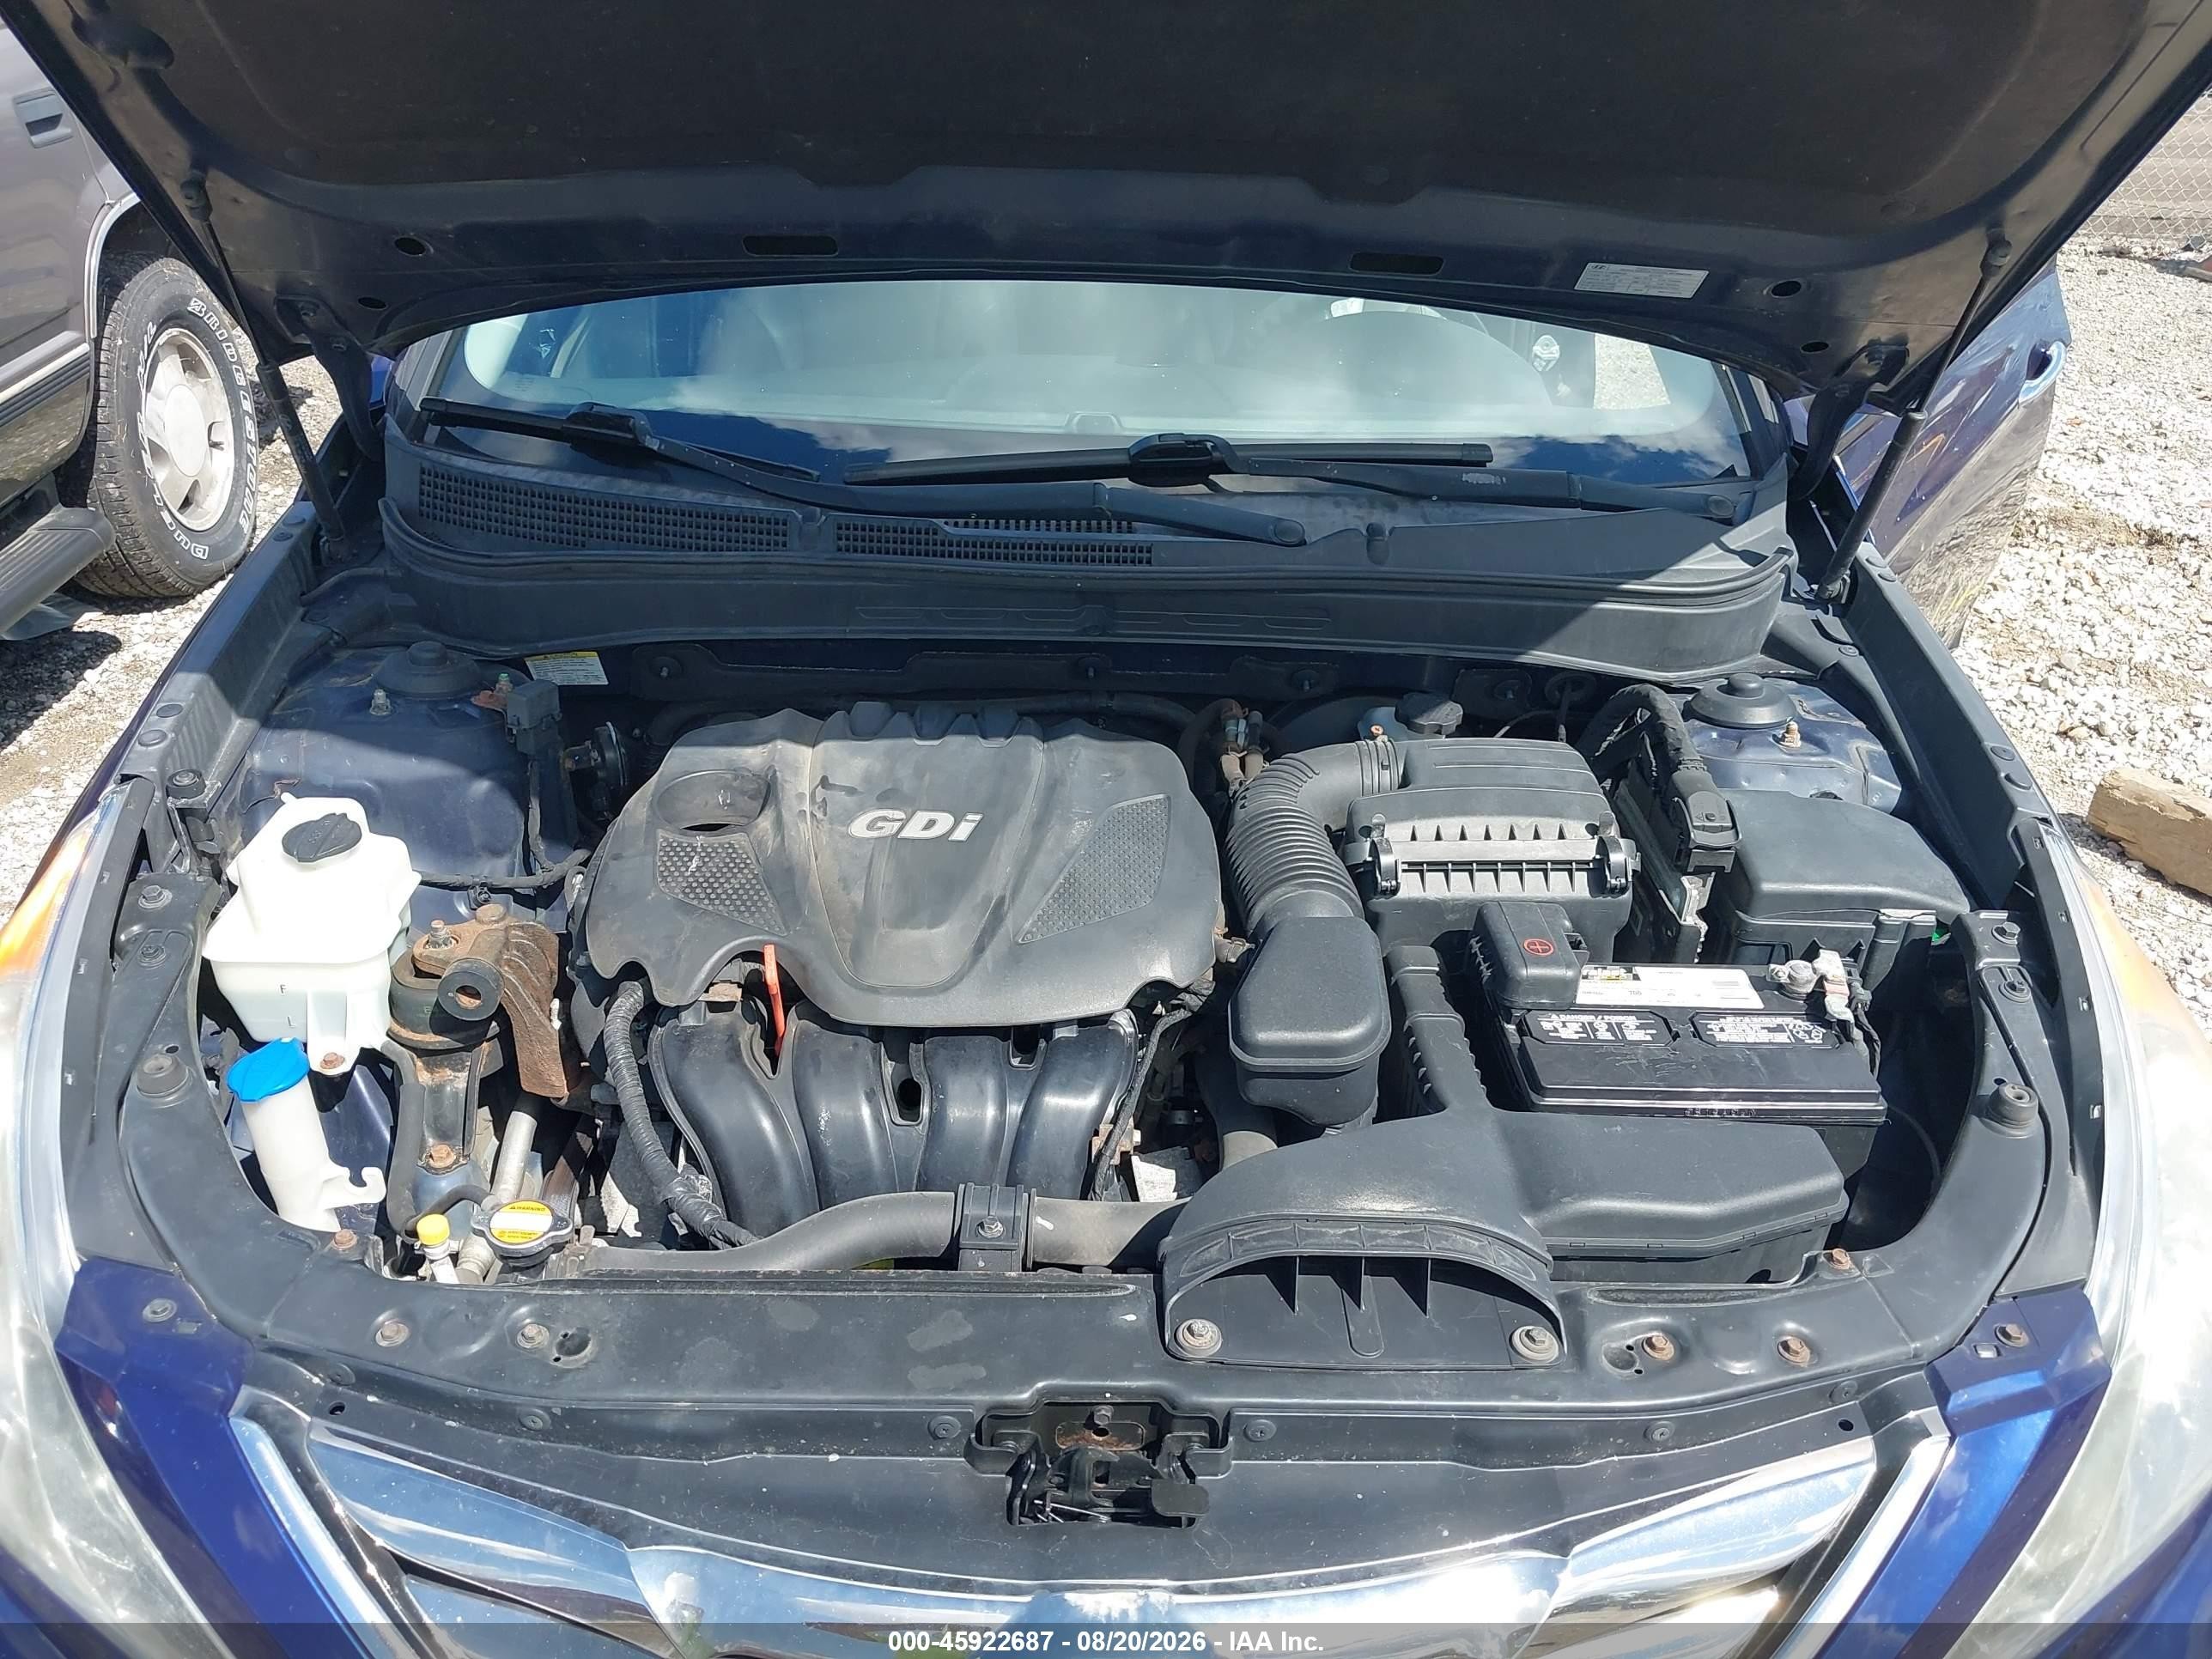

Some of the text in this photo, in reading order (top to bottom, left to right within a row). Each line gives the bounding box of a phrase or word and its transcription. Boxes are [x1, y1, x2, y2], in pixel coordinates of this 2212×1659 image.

[186, 298, 258, 534] BRIDGESTONE
[848, 809, 982, 842] GDi
[280, 984, 287, 994] F
[288, 1016, 296, 1028] L
